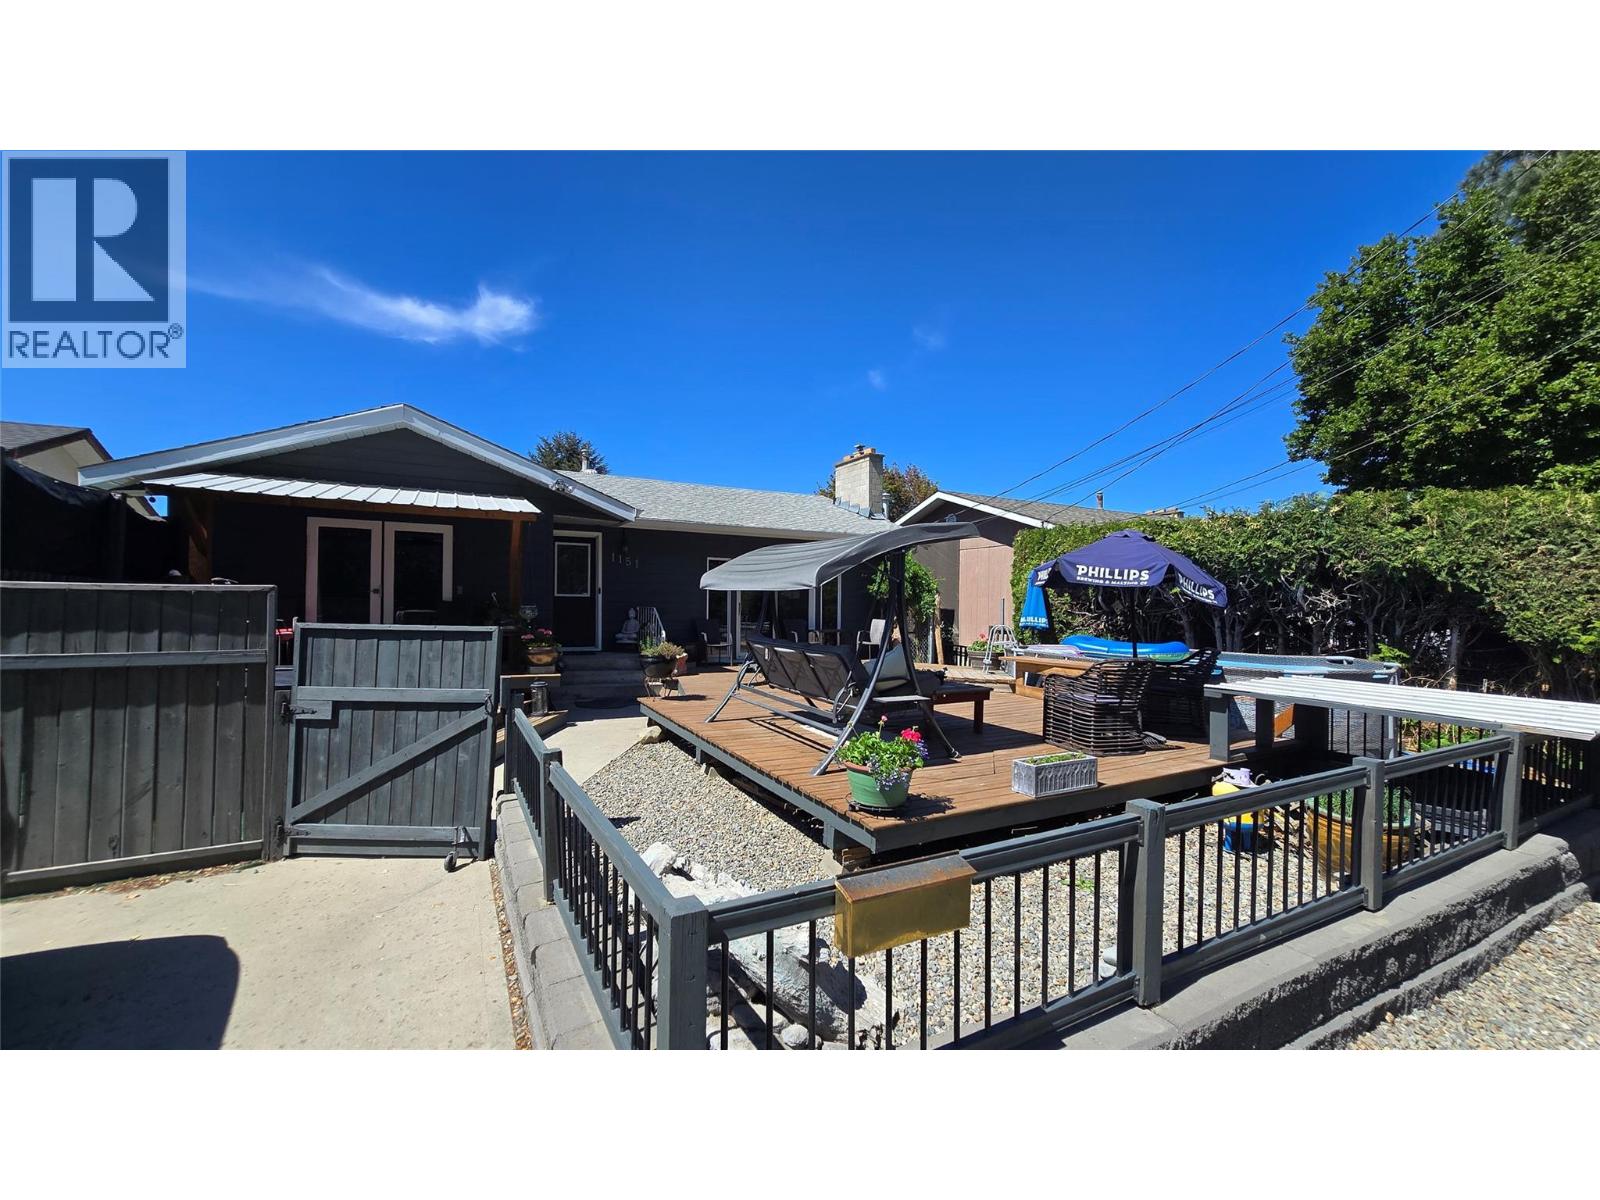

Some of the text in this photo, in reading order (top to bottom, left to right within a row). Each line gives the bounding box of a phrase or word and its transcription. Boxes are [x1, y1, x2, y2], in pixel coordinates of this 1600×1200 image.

[611, 552, 639, 569] 1151
[1076, 564, 1150, 581] PHILLIPS
[1178, 572, 1215, 600] PHILLIPS
